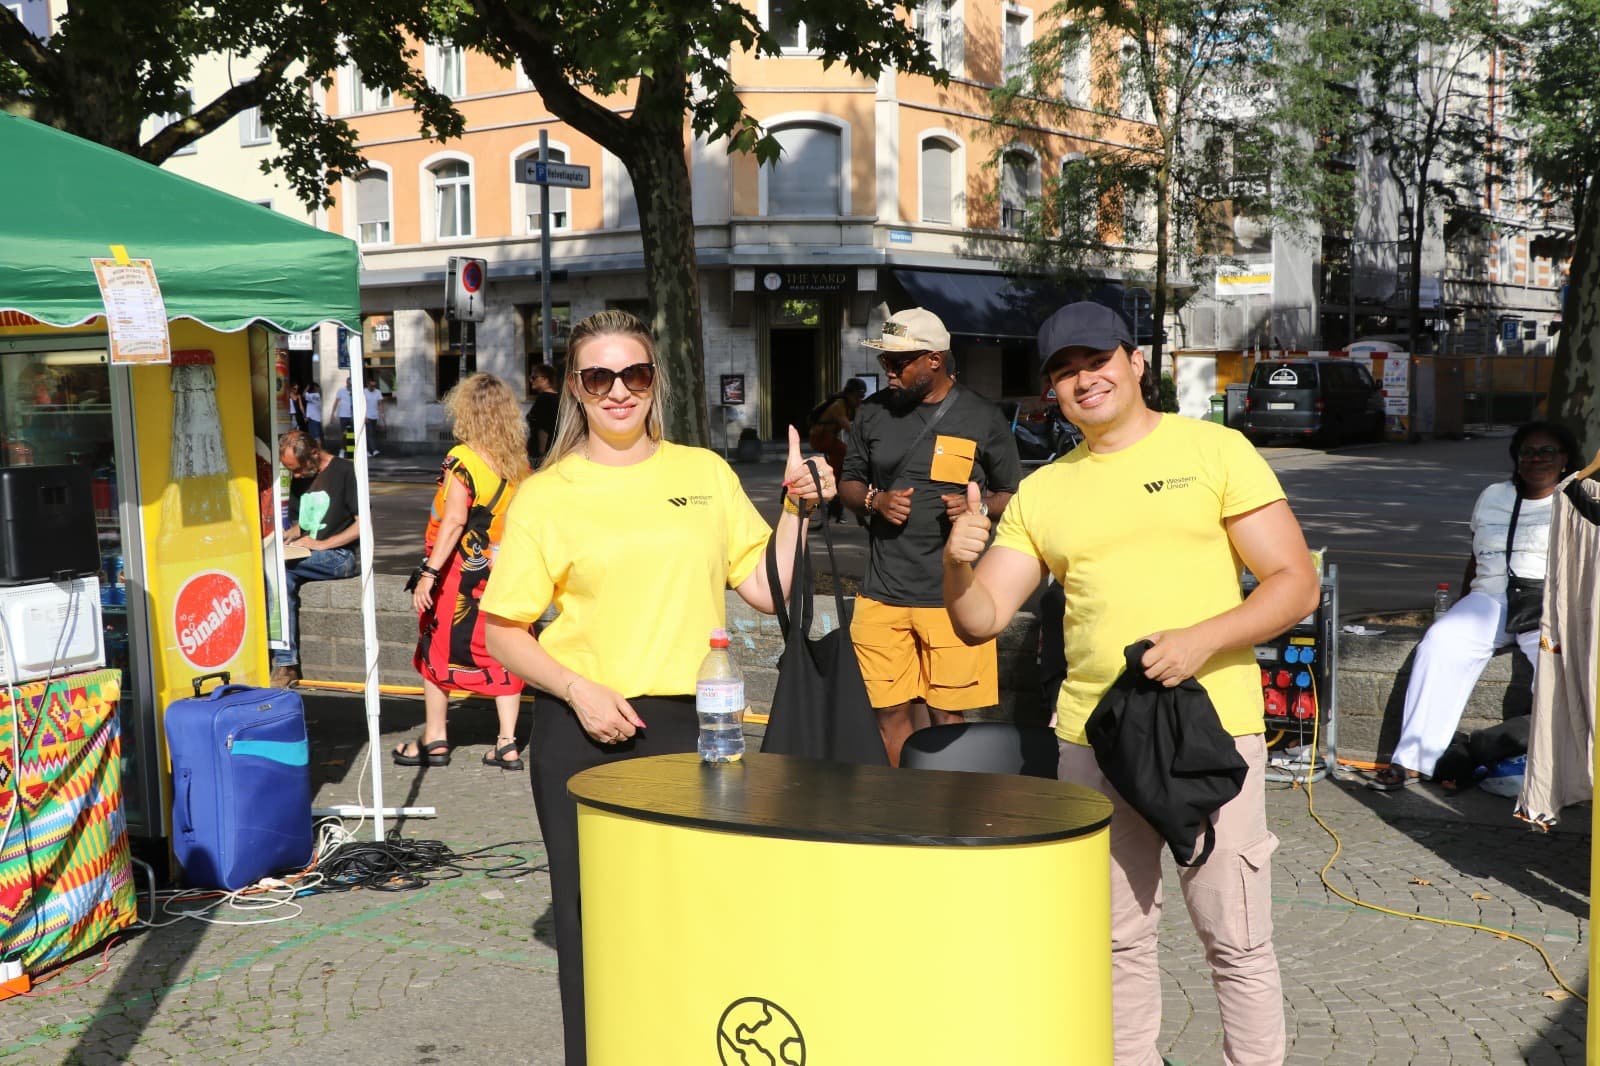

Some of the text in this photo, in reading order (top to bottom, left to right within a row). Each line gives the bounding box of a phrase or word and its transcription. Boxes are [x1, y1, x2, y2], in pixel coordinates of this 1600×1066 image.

[547, 167, 584, 183] Helvetiaplatz
[786, 273, 846, 285] THE YARD
[1166, 476, 1197, 484] Western
[181, 588, 242, 655] Sinalco
